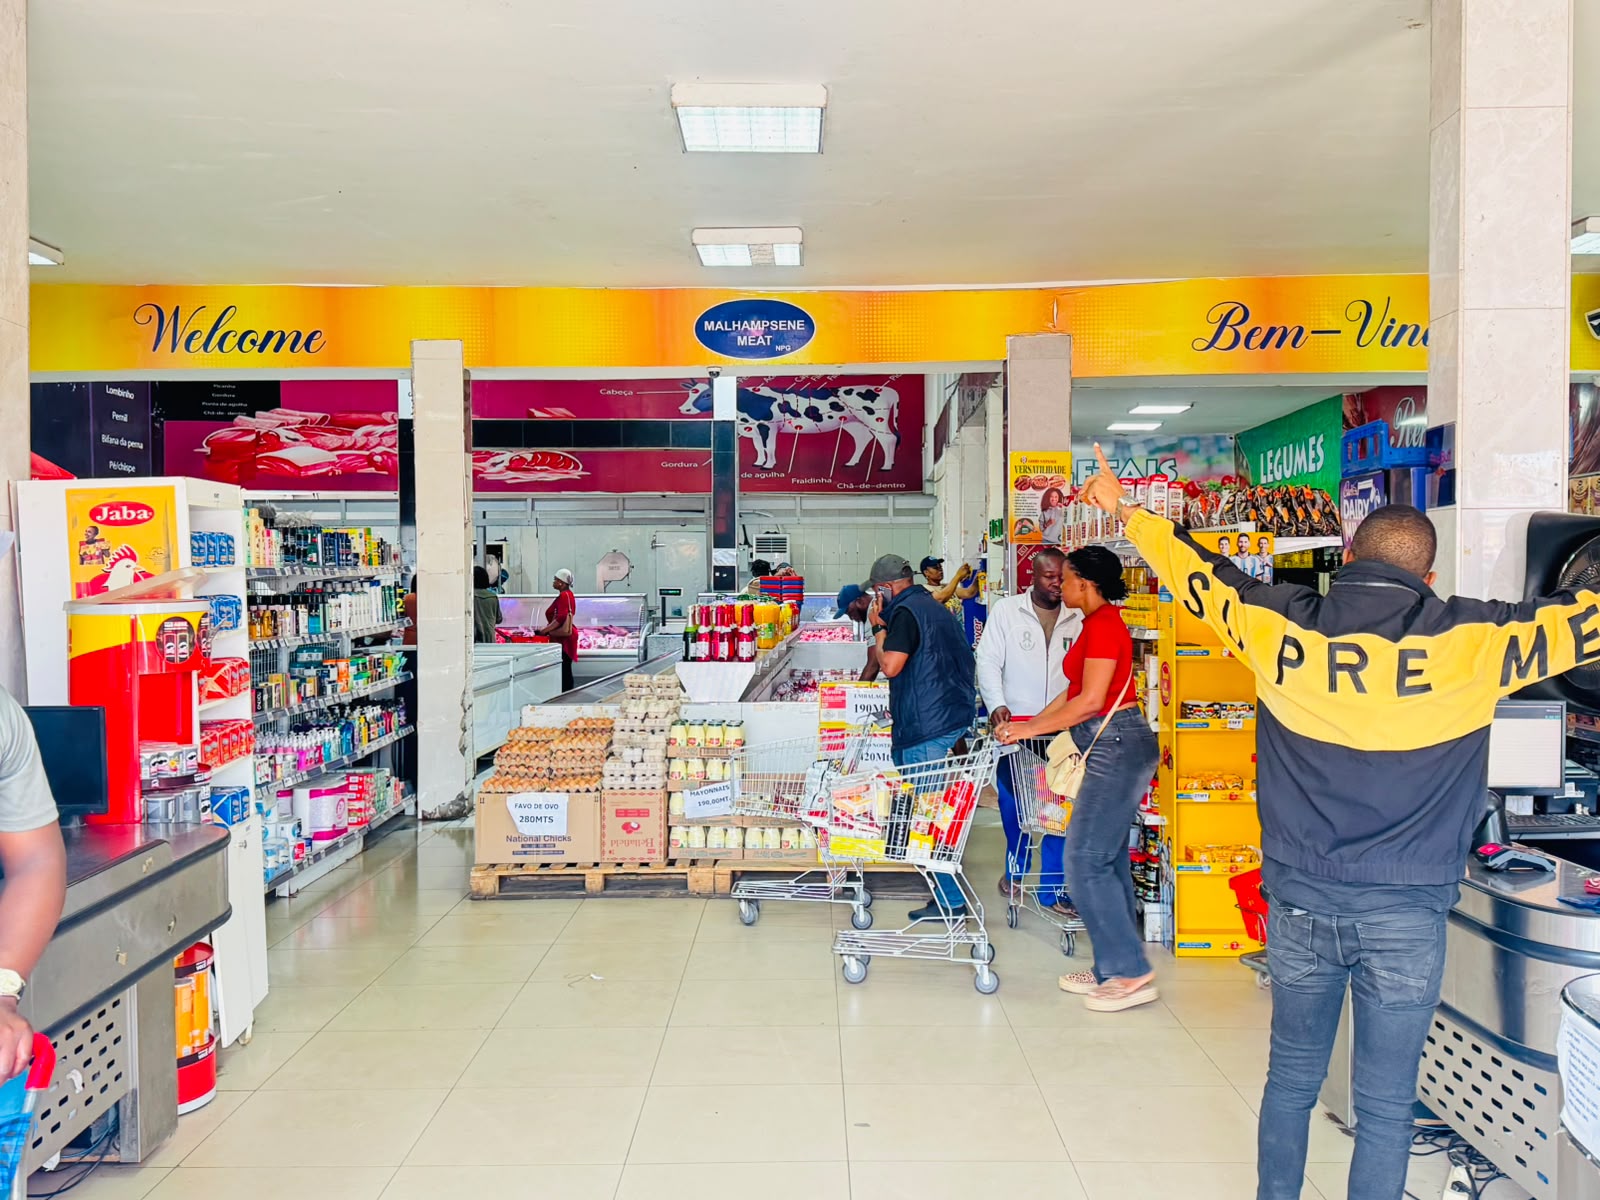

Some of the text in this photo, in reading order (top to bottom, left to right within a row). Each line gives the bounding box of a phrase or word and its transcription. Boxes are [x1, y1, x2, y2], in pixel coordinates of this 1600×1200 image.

[133, 303, 327, 354] Welcome
[704, 320, 805, 331] MALHAMPSENE
[737, 335, 773, 346] MEAT
[106, 384, 135, 400] Lombinho
[600, 388, 634, 396] Cabeça
[112, 411, 129, 423] Pernil
[101, 434, 119, 446] Bifana
[119, 436, 127, 447] da
[1260, 433, 1325, 484] LEGUMES
[754, 471, 785, 479] agulha
[1014, 465, 1067, 474] VERSATILIDADE
[1072, 457, 1178, 486] ETAIS
[95, 505, 150, 521] Jaba
[1343, 498, 1370, 520] DAIRY
[690, 784, 730, 797] MAYONNAIS
[519, 815, 554, 823] 280MTS
